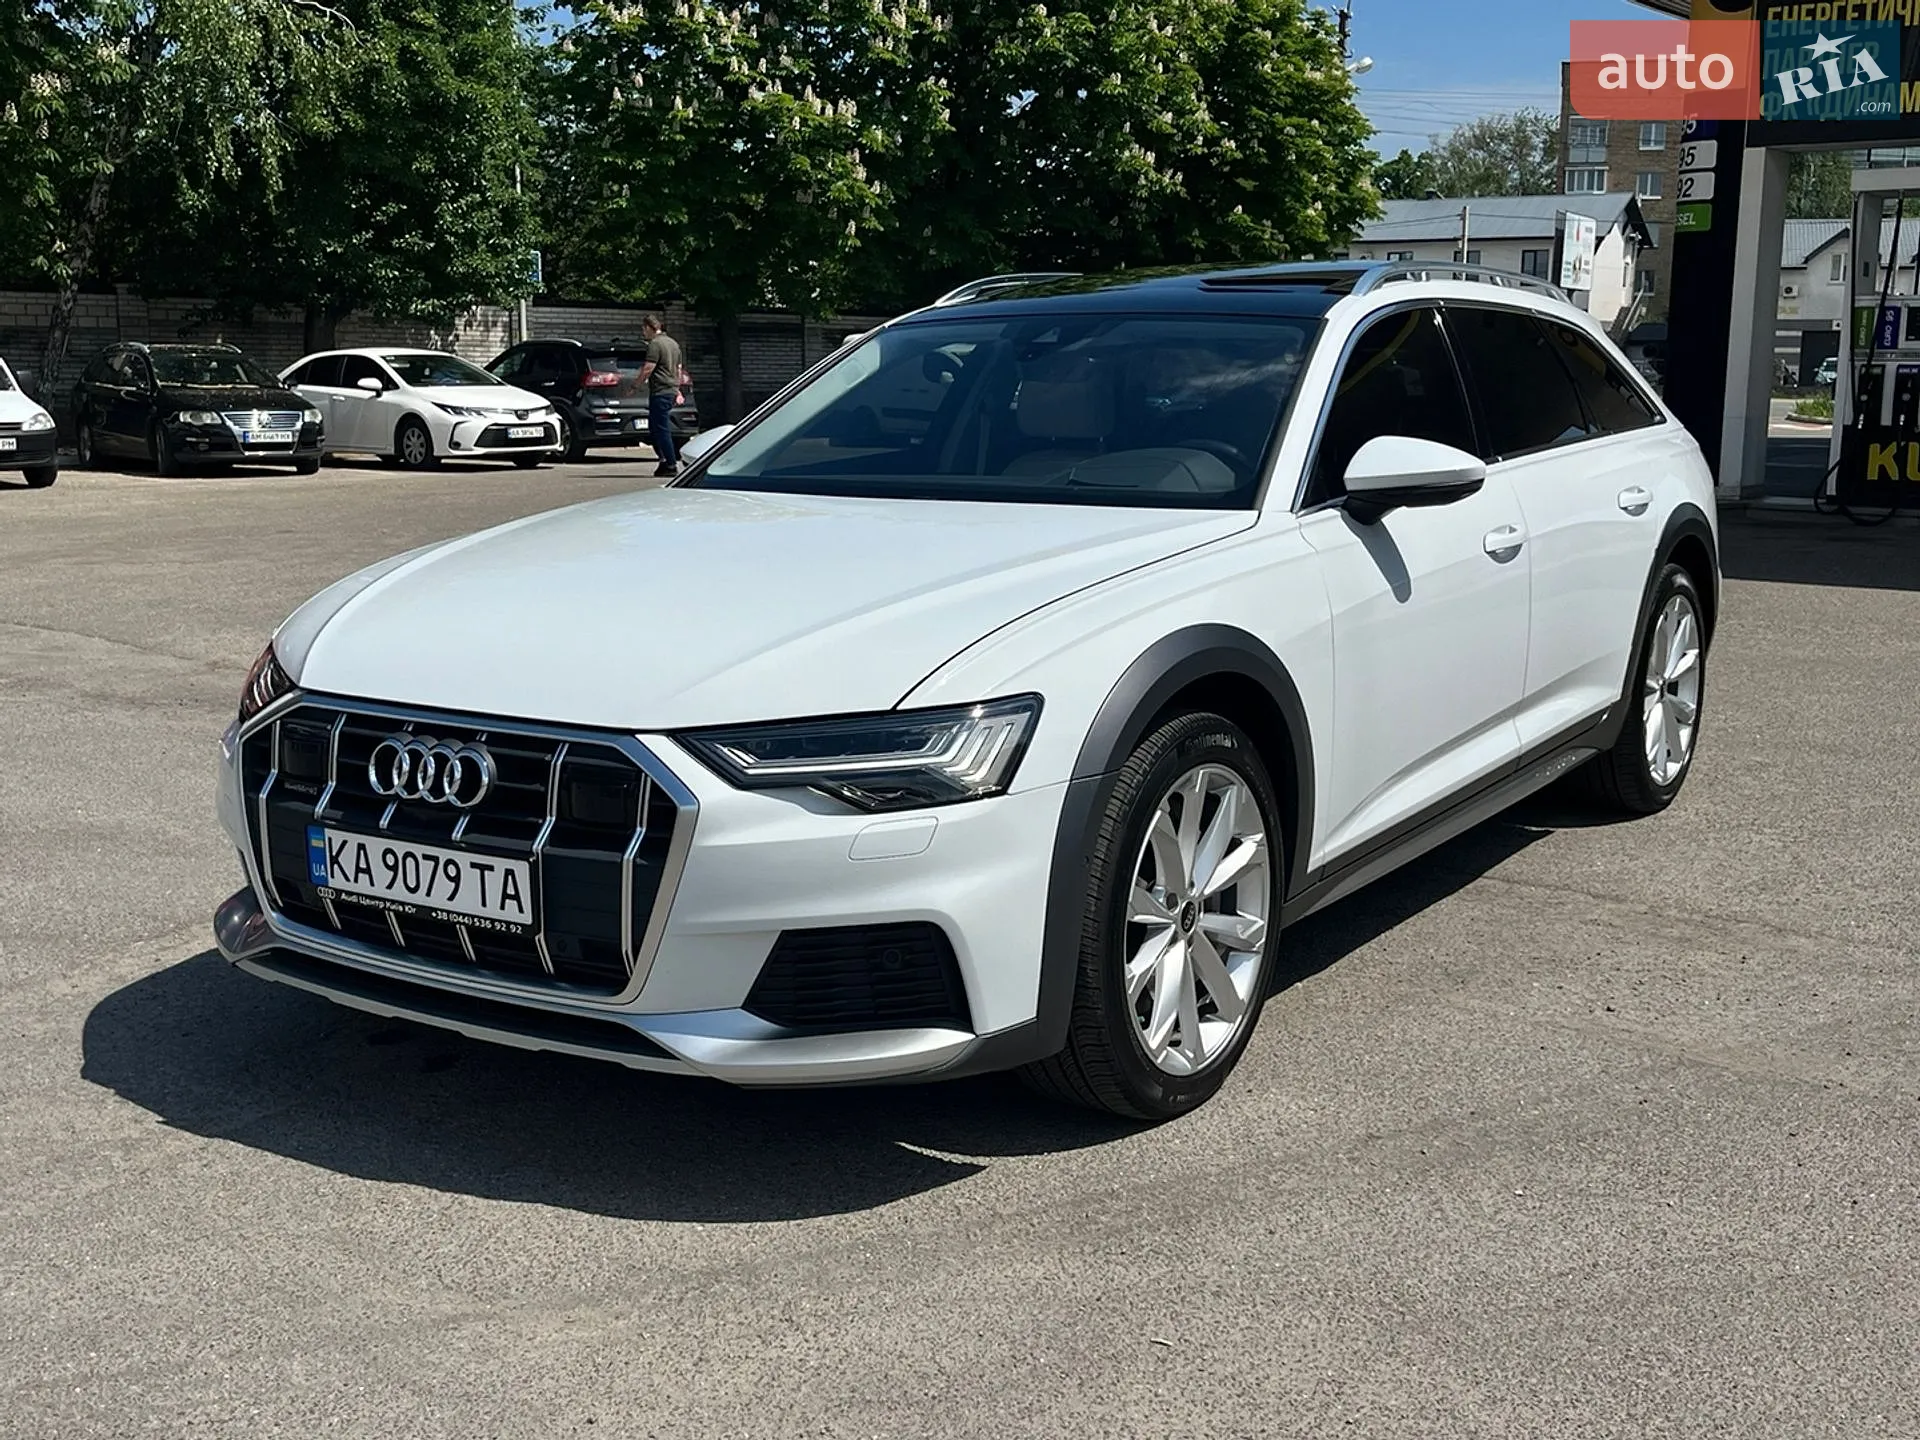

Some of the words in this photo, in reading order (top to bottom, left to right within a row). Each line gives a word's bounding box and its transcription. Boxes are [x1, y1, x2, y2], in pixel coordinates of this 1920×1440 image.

[313, 862, 327, 877] UA
[328, 837, 375, 887] KA
[382, 847, 461, 902] 9079
[470, 861, 525, 914] TA
[341, 892, 359, 902] Audi
[431, 911, 448, 920] +38
[449, 913, 472, 925] (044)
[473, 918, 492, 928] 536
[494, 922, 507, 931] 92
[509, 924, 522, 934] 92
